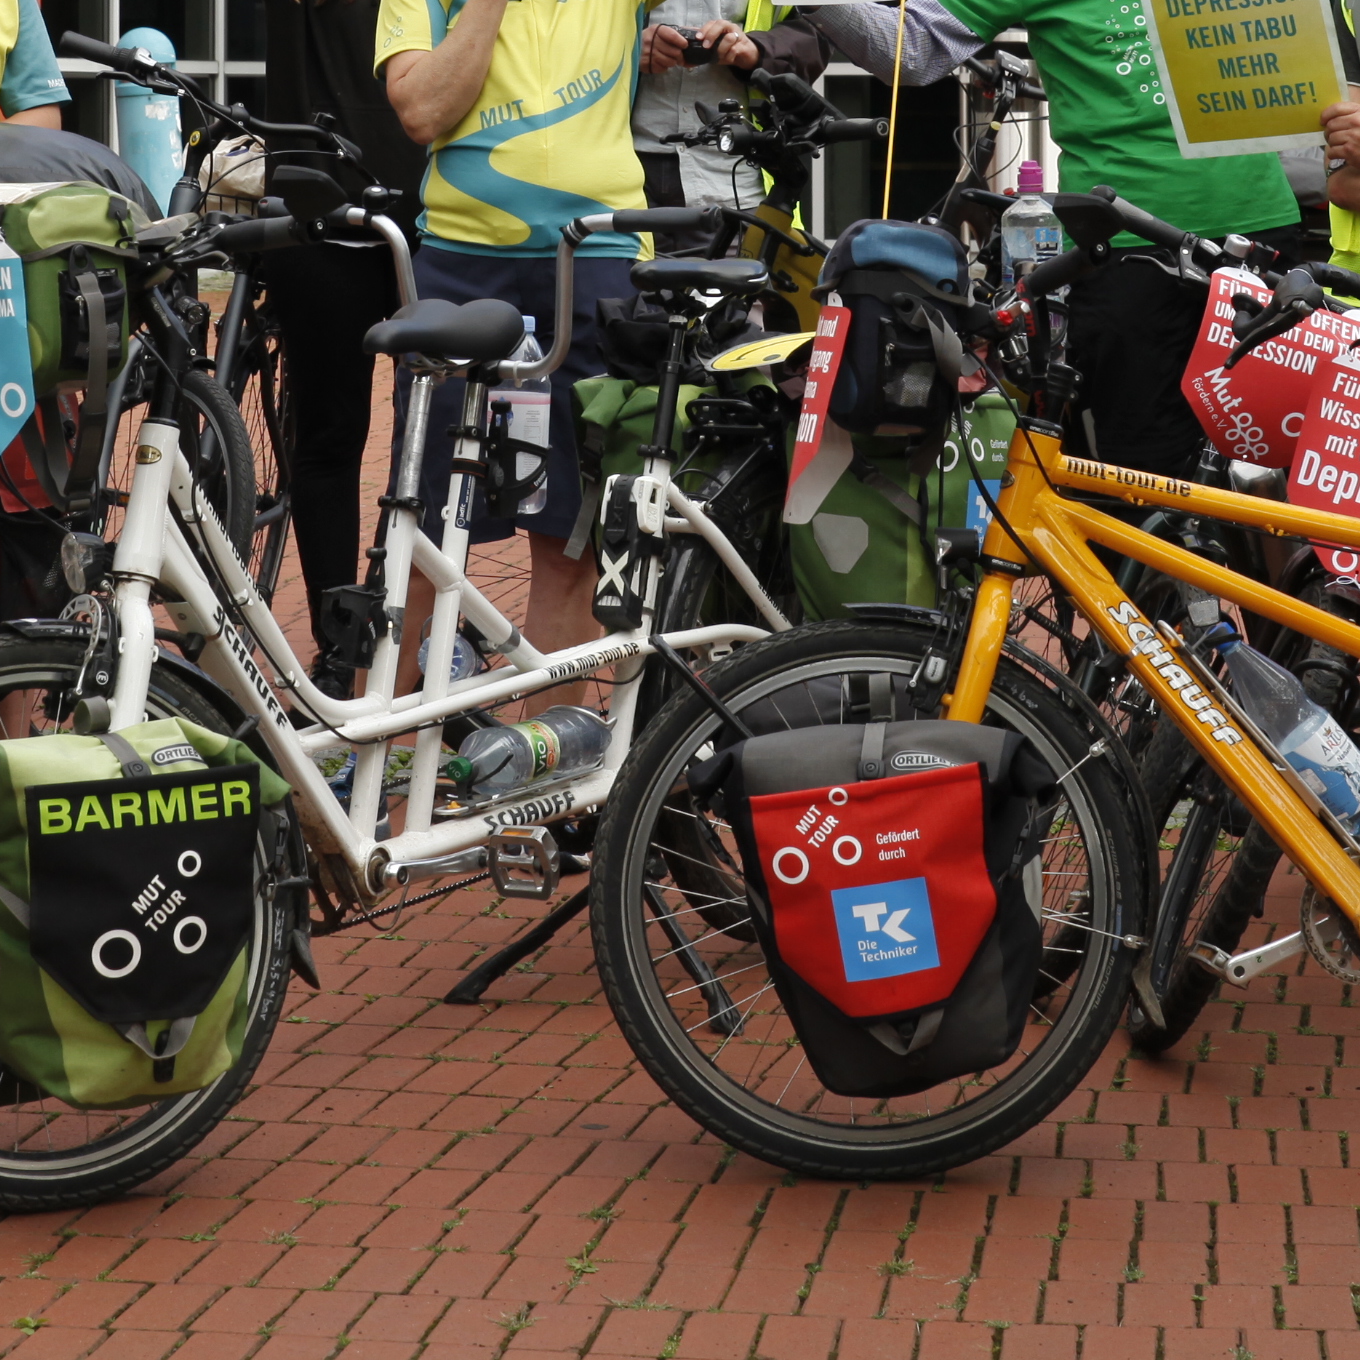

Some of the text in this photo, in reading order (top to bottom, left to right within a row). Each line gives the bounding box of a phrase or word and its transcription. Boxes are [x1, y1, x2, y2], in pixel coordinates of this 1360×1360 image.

[1185, 14, 1297, 50] KEIN TABU
[1217, 52, 1280, 79] MEHR
[553, 68, 606, 106] TOUR
[1196, 81, 1318, 114] SEIN DARF!
[480, 99, 524, 130] MUT
[1303, 332, 1334, 355] DEM
[1191, 377, 1215, 414] fördern
[1204, 365, 1242, 413] Mut
[1325, 433, 1355, 458] mit
[1066, 456, 1191, 497] mut-tour.de
[213, 605, 288, 729] SCHAUFF
[1107, 600, 1244, 747] SCHAUFF
[39, 780, 252, 835] BARMER
[483, 791, 576, 837] SCHAUFF
[795, 804, 822, 836] MUT
[808, 814, 840, 850] TOUR
[876, 828, 920, 845] Gefördert
[878, 846, 906, 861] durch
[131, 873, 168, 916] MUT
[144, 888, 187, 934] TOUR
[851, 901, 917, 943] TK
[857, 940, 878, 952] Die
[860, 945, 918, 963] Techniker
